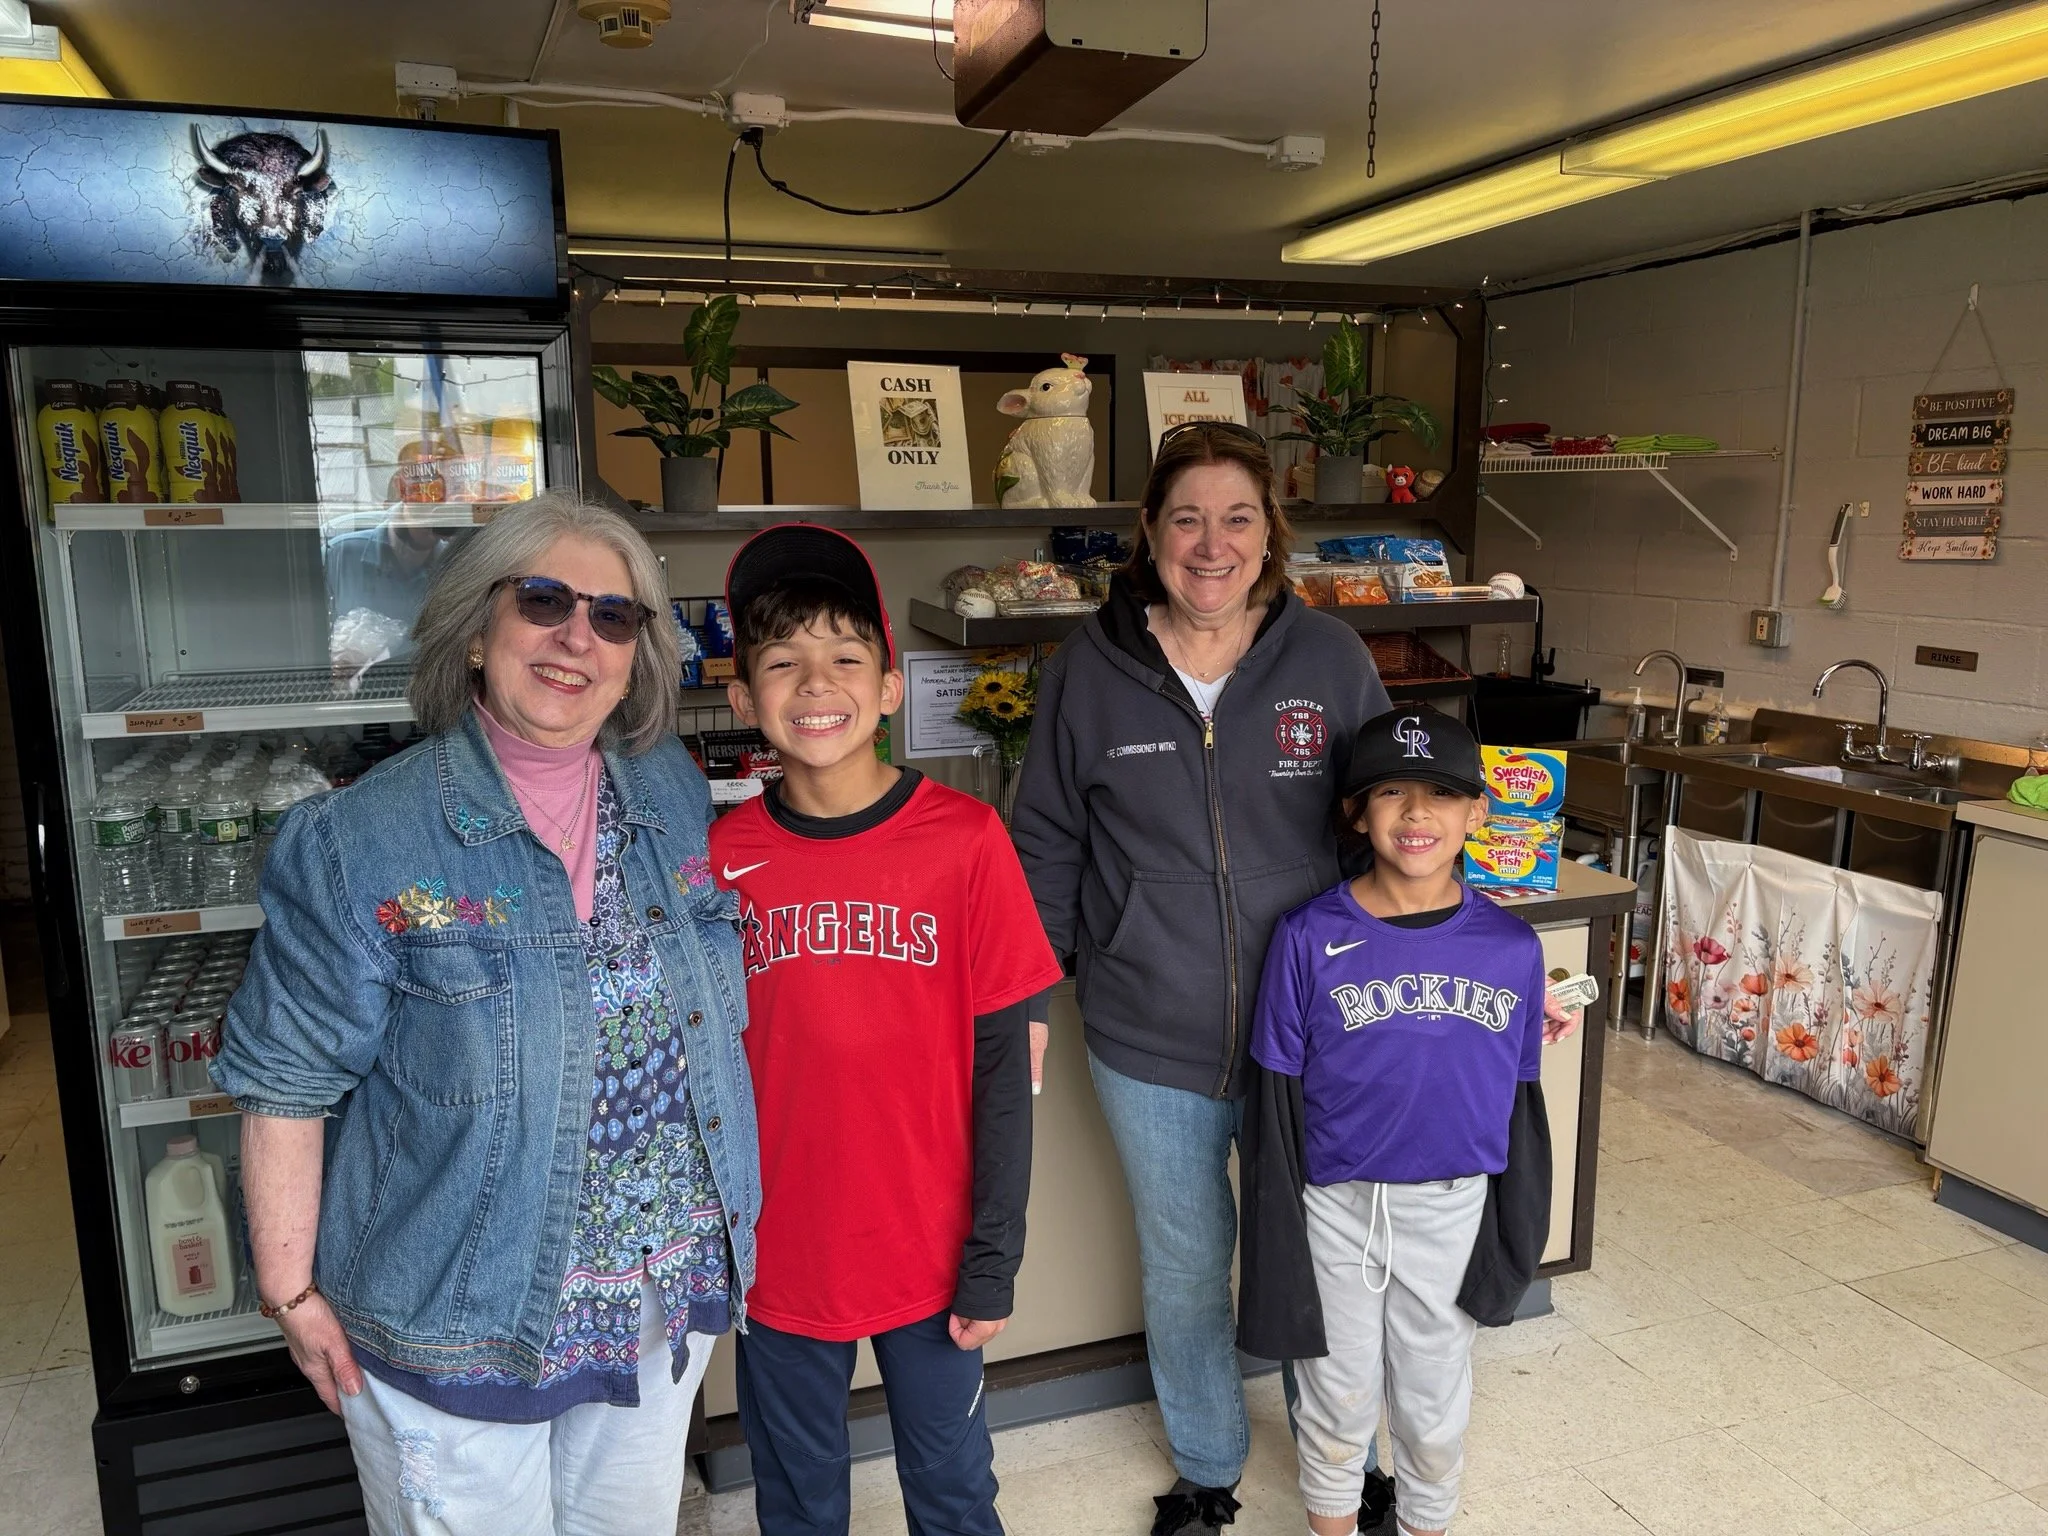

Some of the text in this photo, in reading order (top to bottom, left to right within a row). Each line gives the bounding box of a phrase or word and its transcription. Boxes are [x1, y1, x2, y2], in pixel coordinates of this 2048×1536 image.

[880, 377, 932, 393] CASH
[1183, 390, 1210, 403] ALL
[1929, 398, 1996, 412] BE POSITIVE
[1163, 413, 1234, 426] ICE CREAM
[1928, 425, 1992, 441] DREAM BIG
[54, 422, 81, 482] Nesquik
[103, 421, 127, 480] Nesquik
[180, 421, 205, 481] Nesquik
[888, 450, 940, 465] ONLY
[403, 460, 437, 478] SUNNY
[450, 461, 482, 478] SUNNY
[496, 463, 530, 478] SUNNY
[1927, 452, 1987, 474] BE kind
[915, 480, 960, 494] Thank You
[1922, 485, 1986, 500] WORK HARD
[1916, 516, 1987, 527] STAY HUMBLE
[1917, 540, 1978, 557] Keep Smiling
[1931, 652, 1962, 664] RINSE
[936, 688, 973, 698] SATISF
[1275, 698, 1324, 713] CLOSTER
[706, 743, 762, 759] HERSHEY'S
[1116, 742, 1158, 757] COMMISSIONER
[1278, 760, 1322, 769] FIRE DEPT
[1493, 765, 1548, 784] Swedish
[1505, 777, 1536, 792] Fish
[1508, 791, 1534, 801] mini
[1487, 848, 1532, 860] Swedish
[1496, 855, 1522, 868] Fish
[1499, 866, 1520, 876] mini
[130, 917, 162, 927] WATER
[740, 901, 938, 980] ANGELS
[1329, 973, 1519, 1032] ROCKIES
